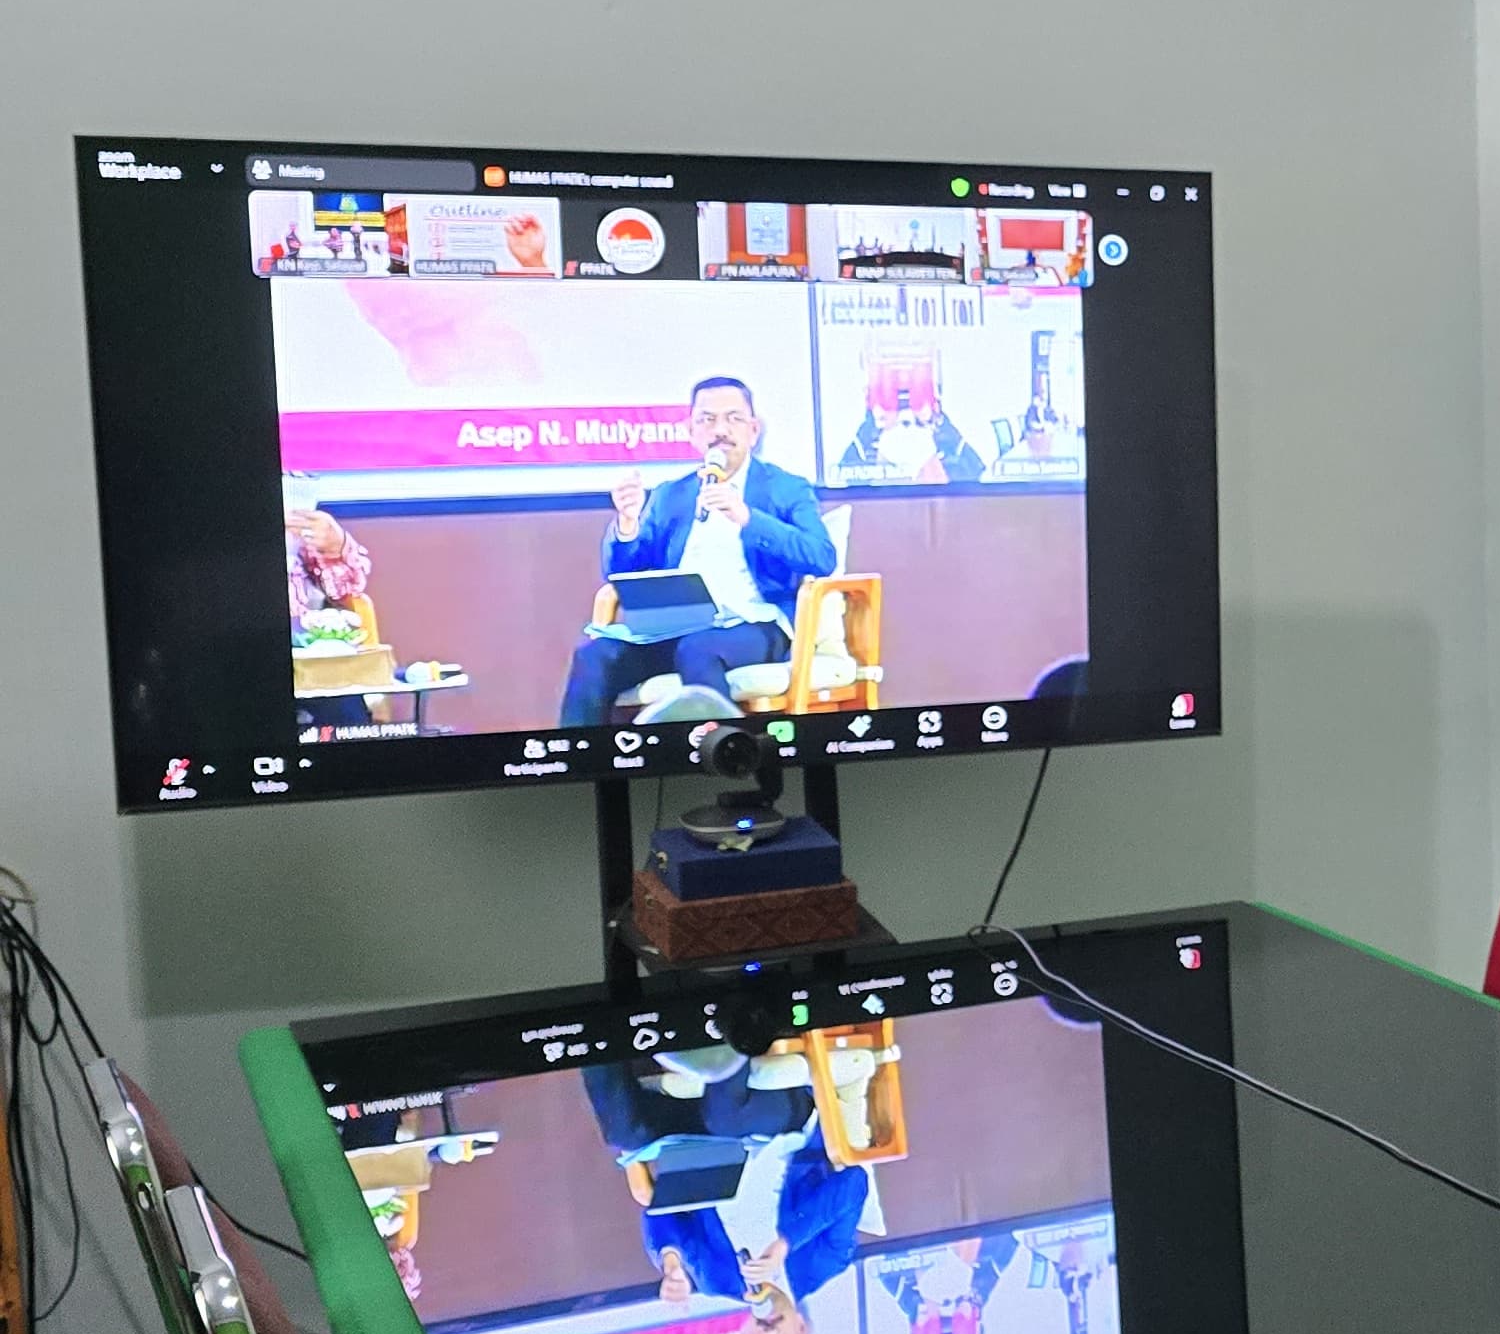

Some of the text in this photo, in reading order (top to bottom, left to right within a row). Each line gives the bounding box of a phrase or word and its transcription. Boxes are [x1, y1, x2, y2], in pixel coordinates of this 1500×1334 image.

[98, 163, 182, 182] Workplace
[457, 418, 690, 452] Asep N. Mulyana
